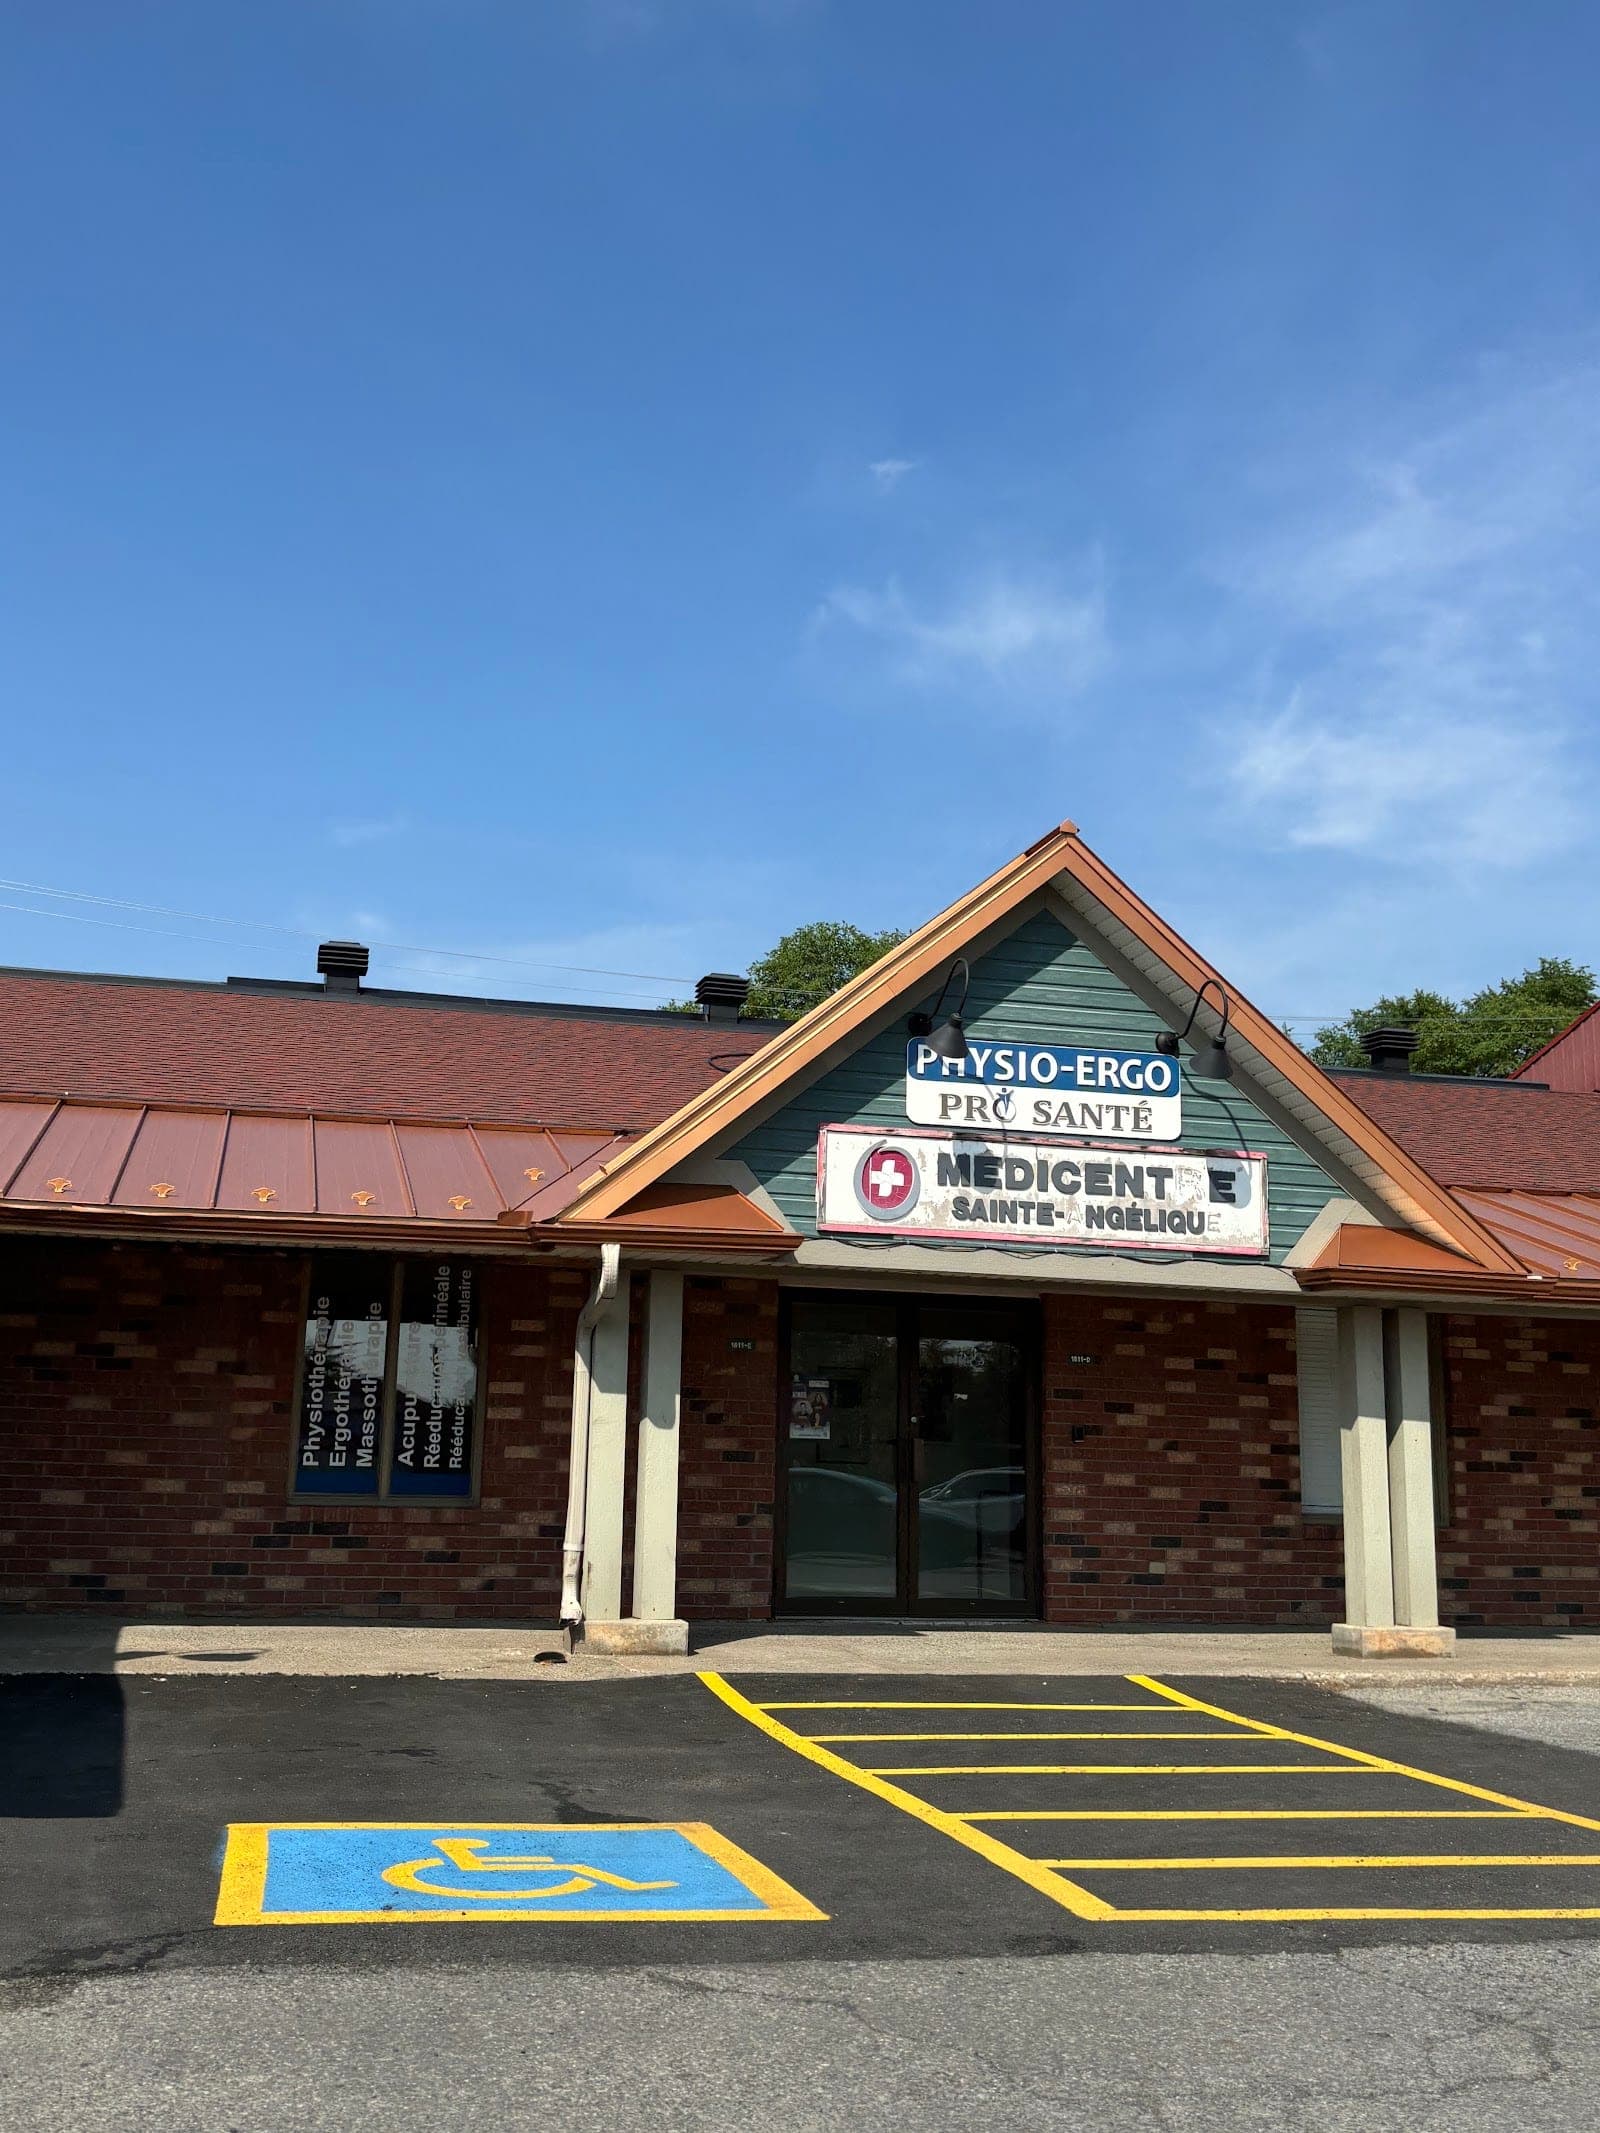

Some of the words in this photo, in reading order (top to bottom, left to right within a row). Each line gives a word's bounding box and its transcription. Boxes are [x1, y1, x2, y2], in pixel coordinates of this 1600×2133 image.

[916, 1043, 1172, 1091] PHYSIO-ERGO
[938, 1092, 1017, 1122] PRO
[1032, 1099, 1153, 1133] SANTÉ
[937, 1152, 1237, 1203] MEDICENTE
[302, 1296, 330, 1467] Physiothérapie
[329, 1320, 355, 1468] Ergothéraie
